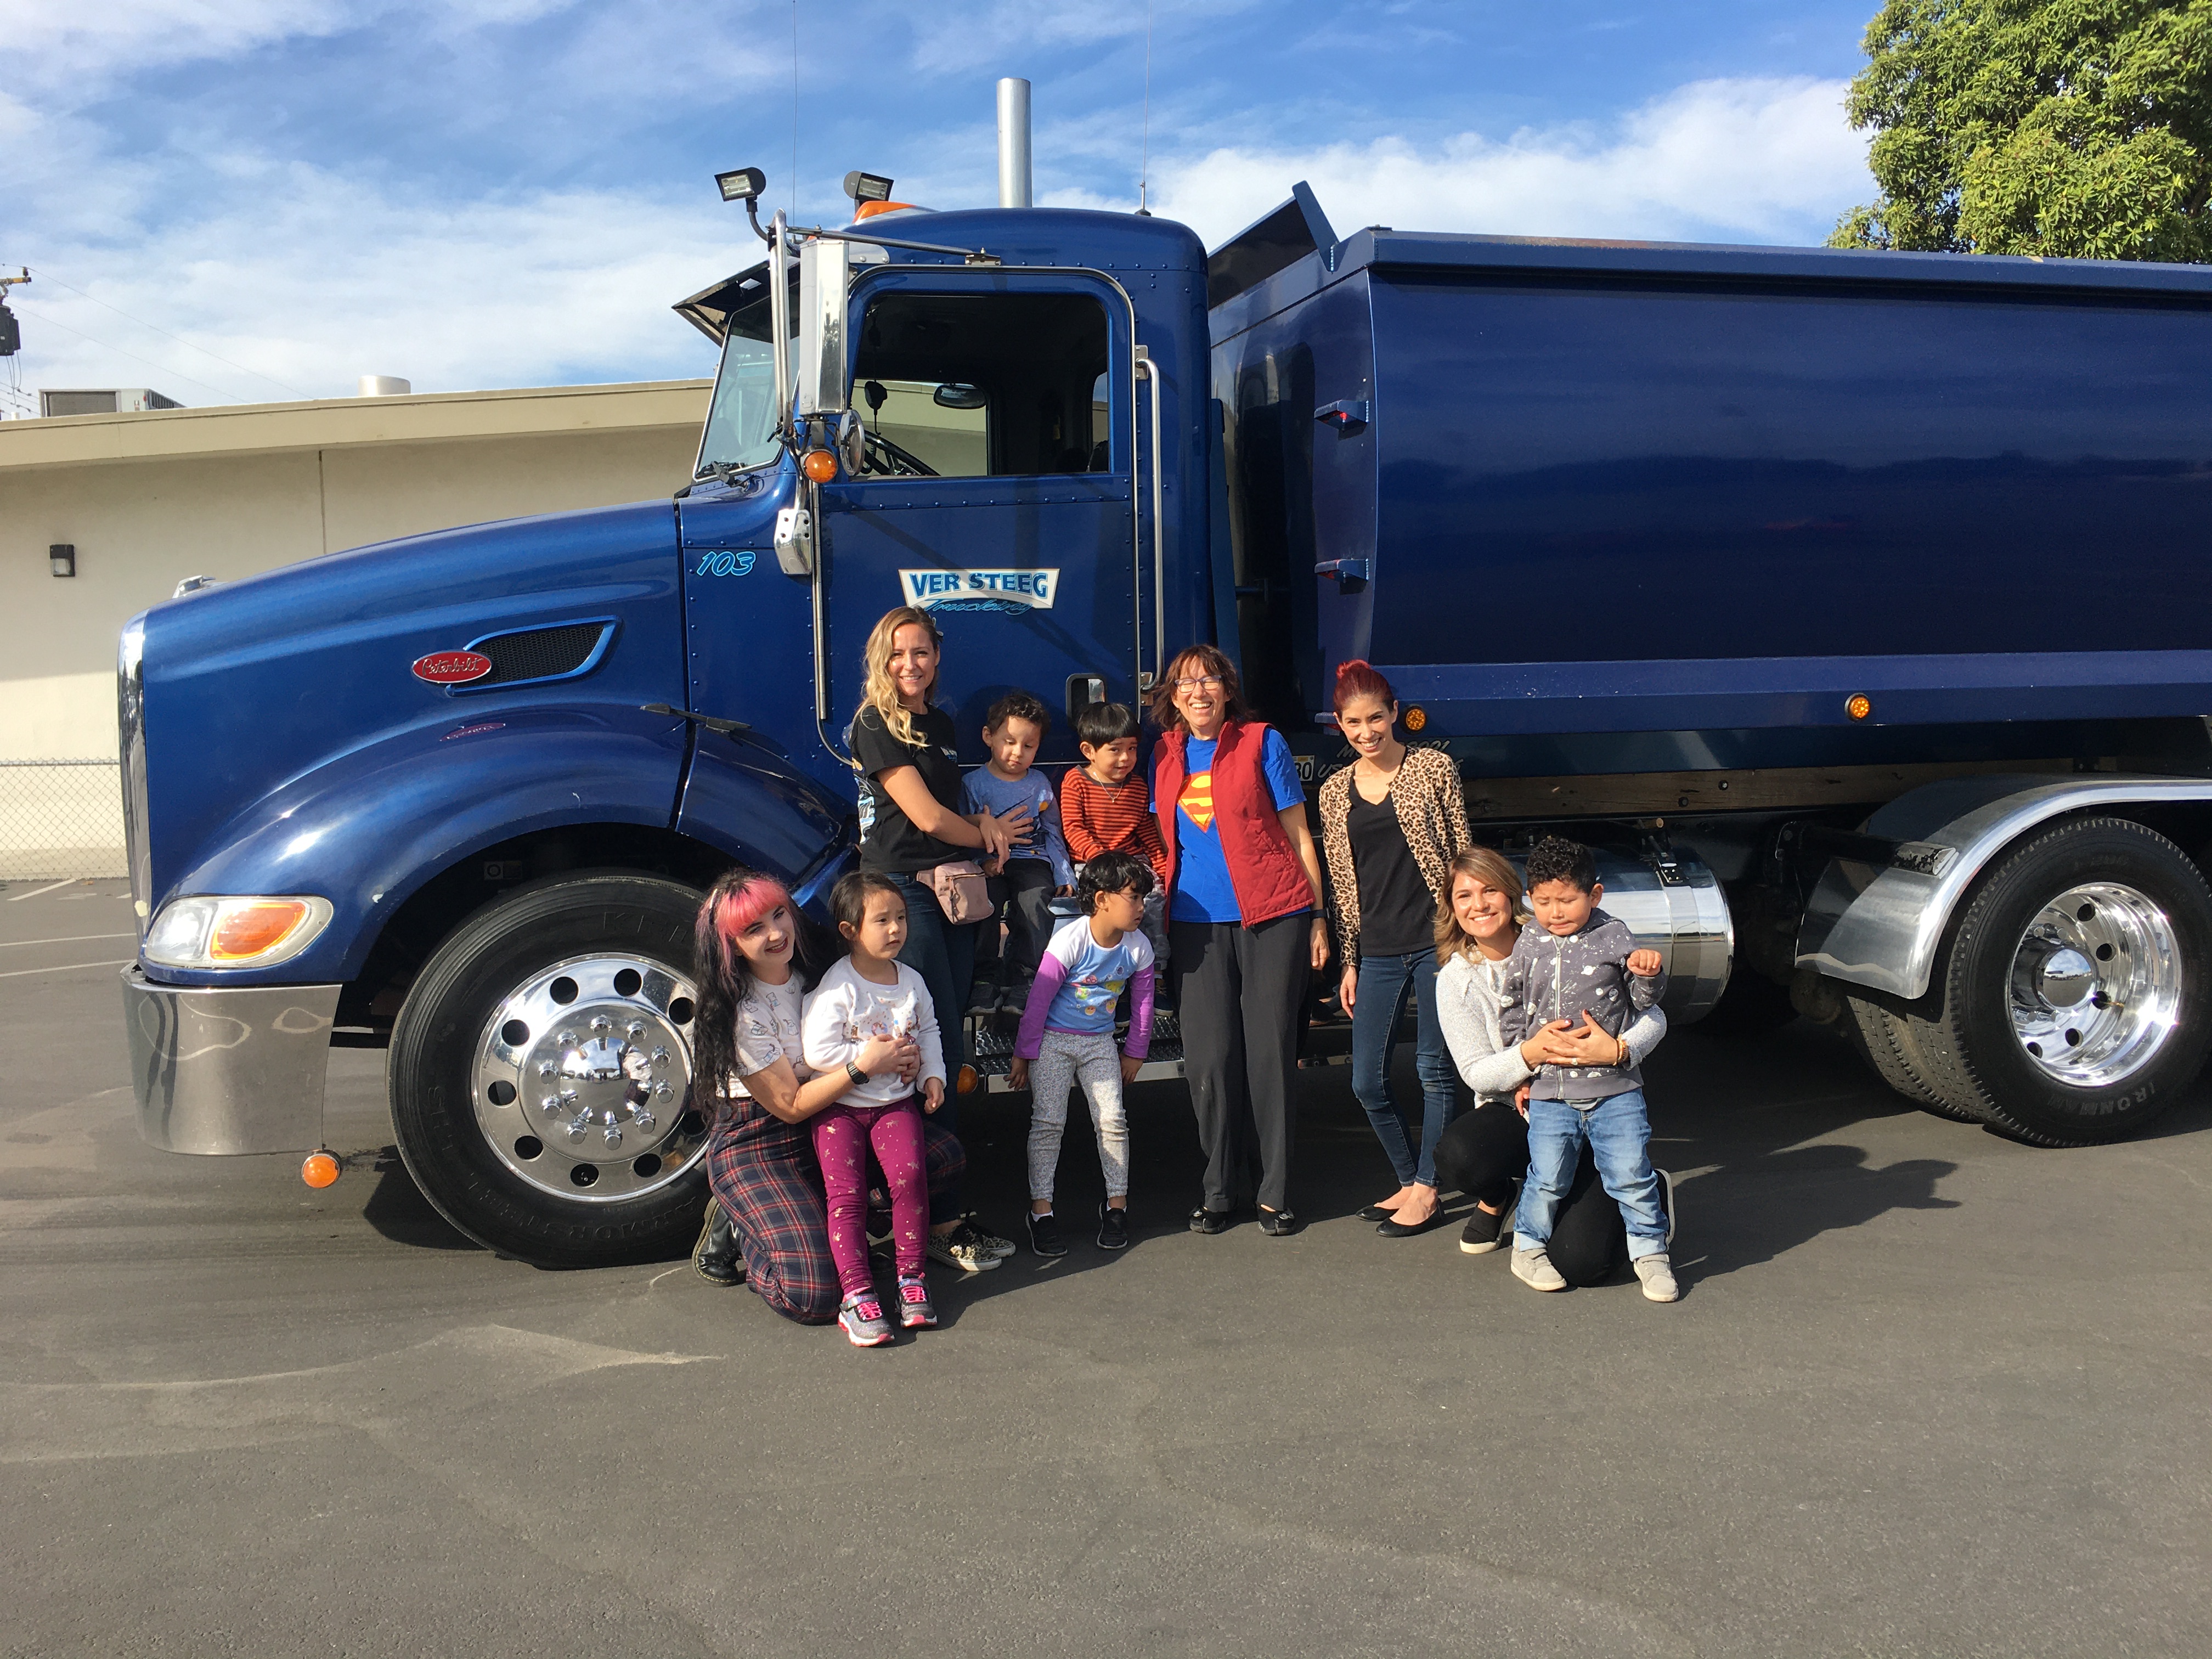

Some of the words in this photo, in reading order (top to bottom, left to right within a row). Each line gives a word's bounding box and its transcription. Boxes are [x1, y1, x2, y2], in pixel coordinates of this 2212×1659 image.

[696, 551, 756, 577] 103
[909, 573, 961, 599] VER
[968, 573, 1048, 599] STEEG
[924, 597, 1034, 616] Trucking
[422, 657, 484, 676] Peterbilt
[2046, 1081, 2157, 1116] IRONMAN
